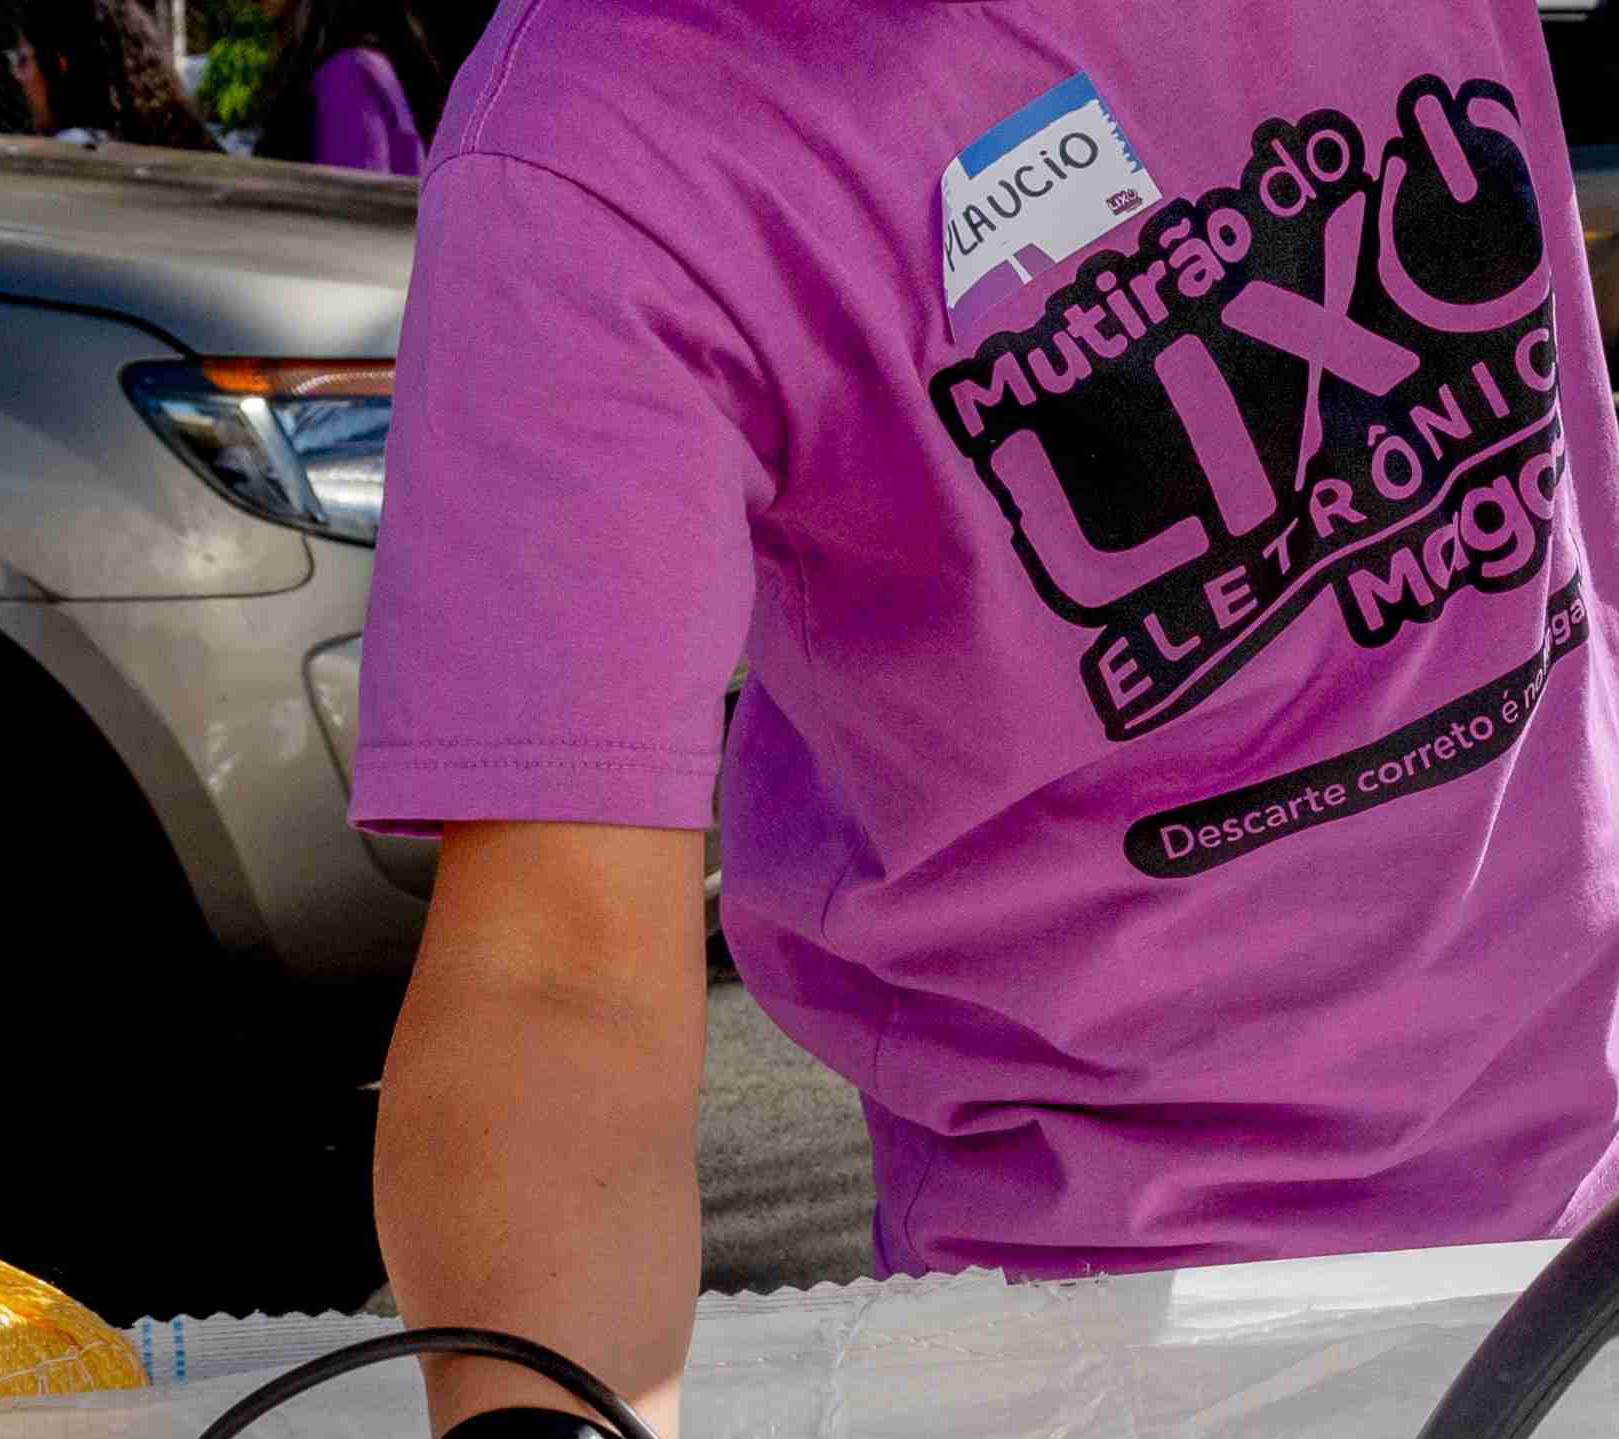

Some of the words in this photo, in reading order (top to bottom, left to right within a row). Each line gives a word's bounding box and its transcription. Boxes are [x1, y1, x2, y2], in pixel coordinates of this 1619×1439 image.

[950, 208, 1253, 438] Mutirão
[1259, 129, 1350, 218] do
[990, 93, 1551, 608] LIXO
[1096, 329, 1557, 710] ELETRÔNIC
[1159, 779, 1348, 861] Descarte
[1356, 713, 1496, 793] correto
[1501, 689, 1519, 724] é
